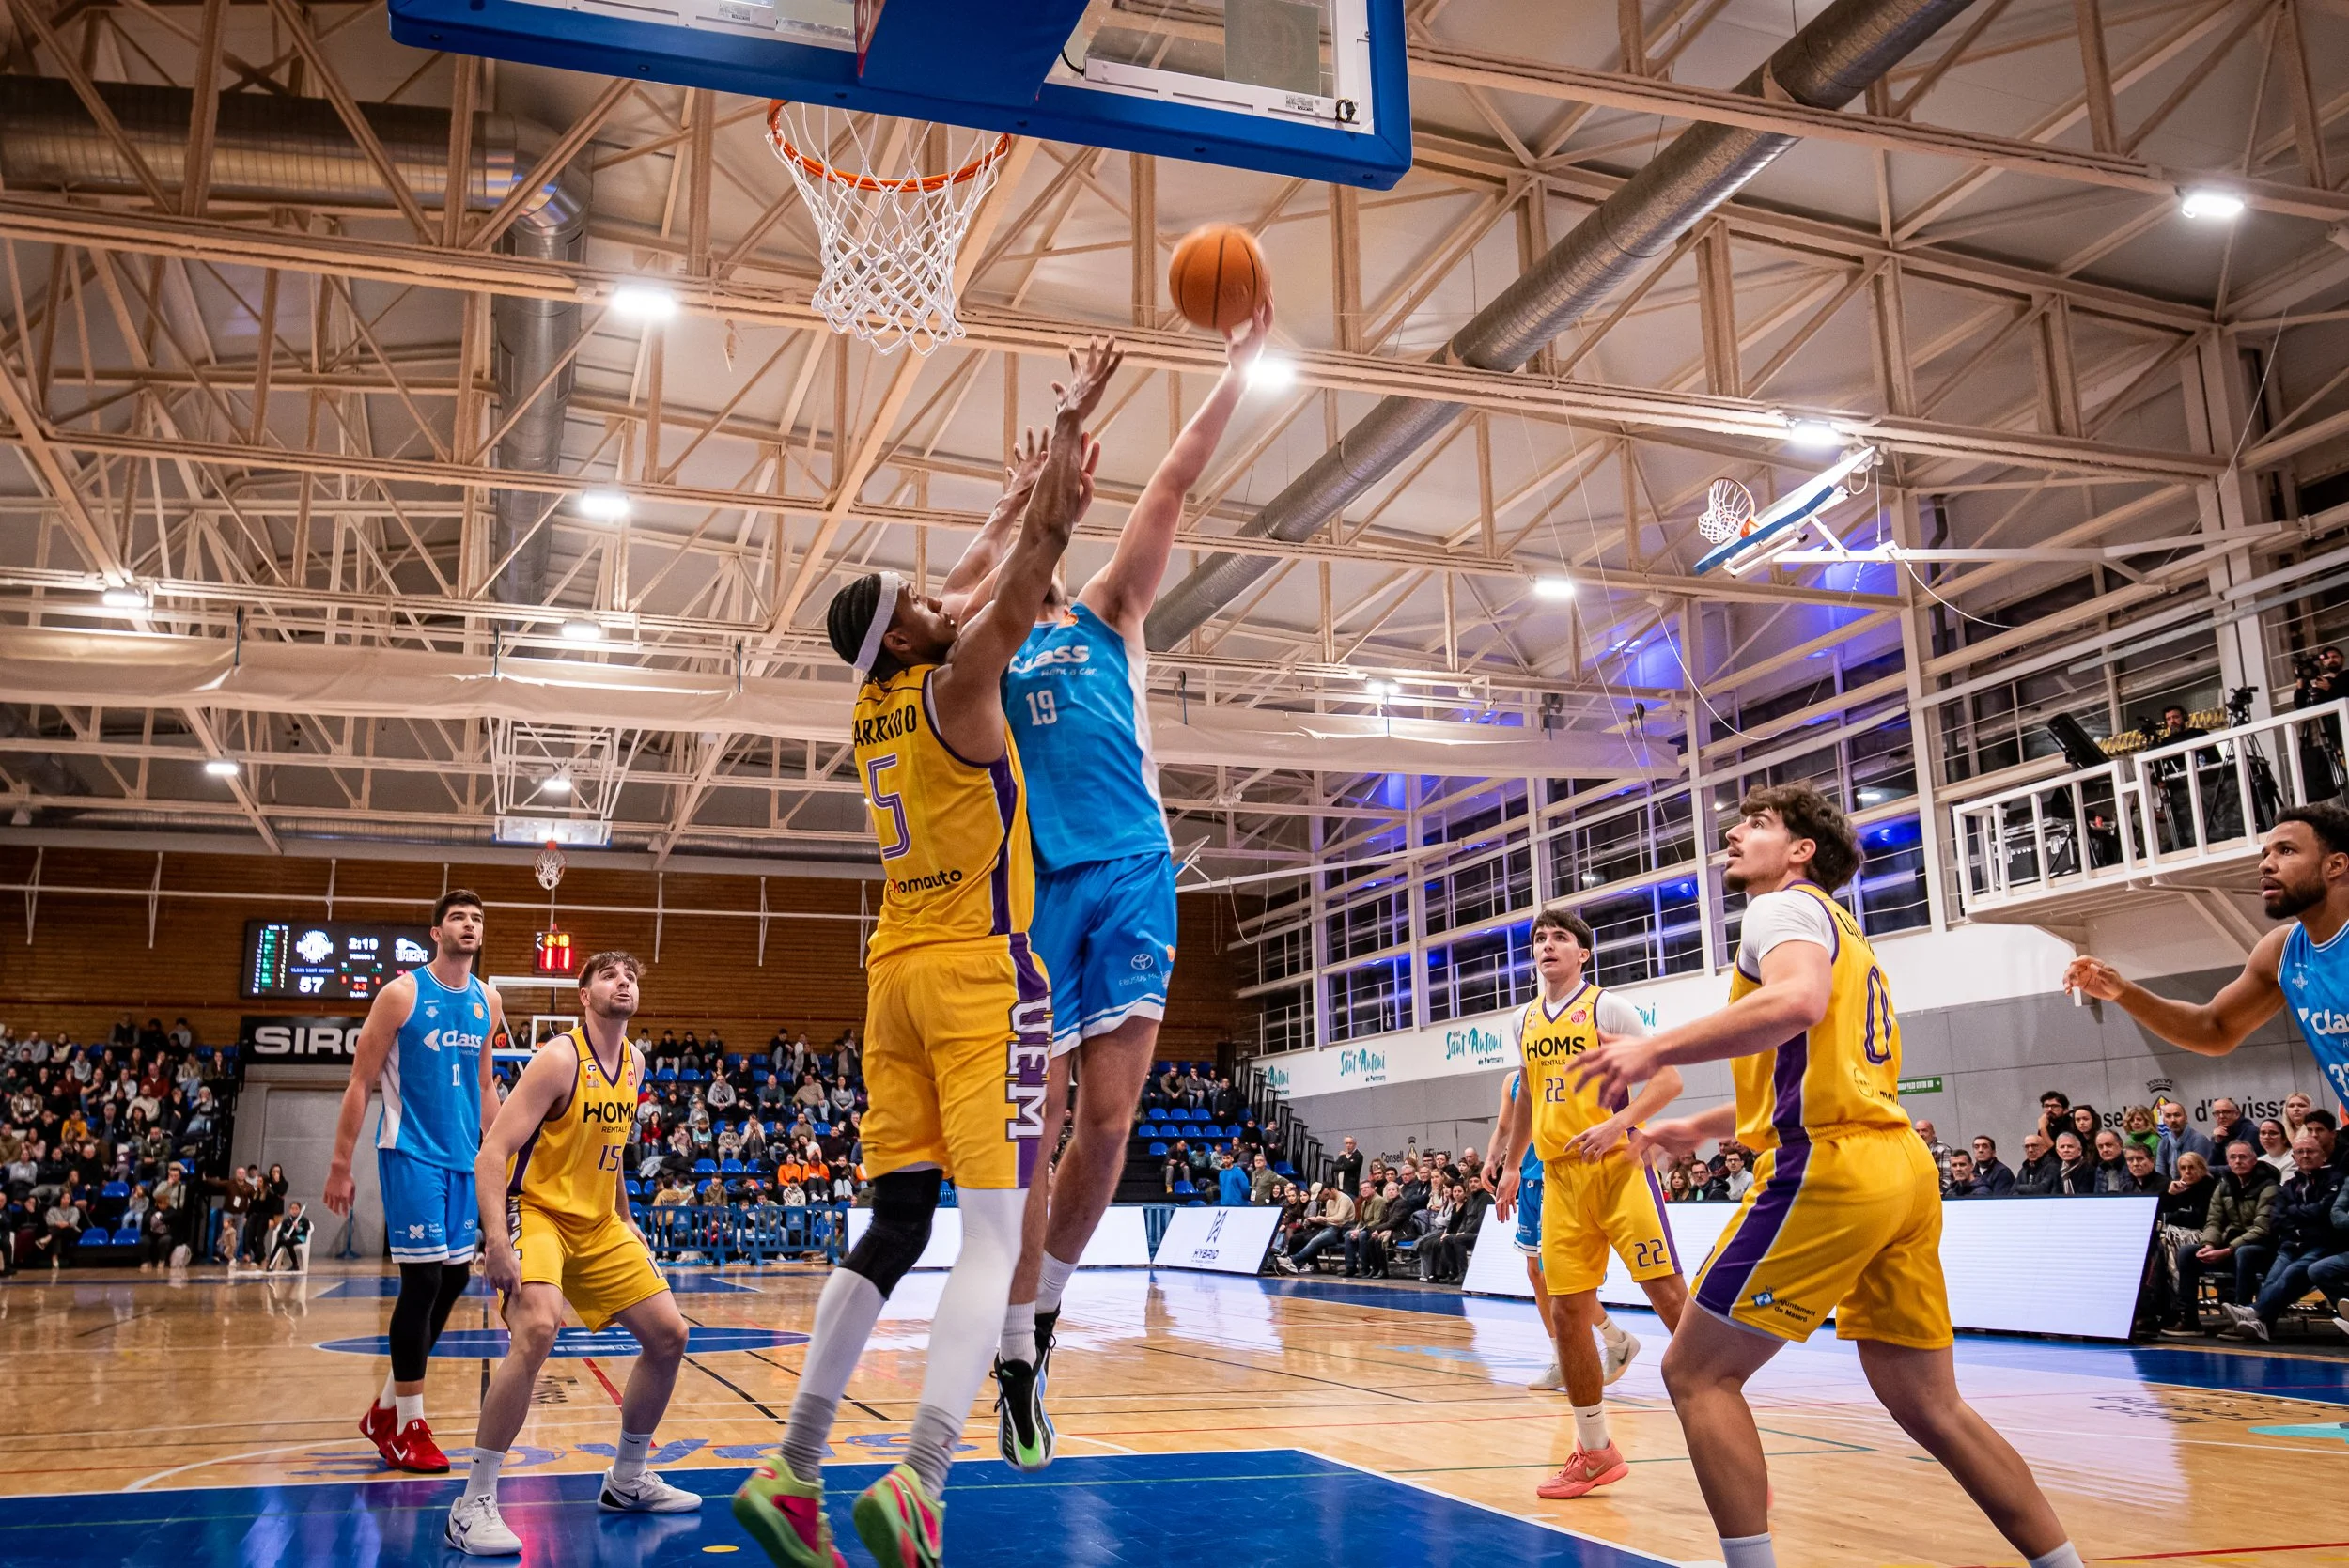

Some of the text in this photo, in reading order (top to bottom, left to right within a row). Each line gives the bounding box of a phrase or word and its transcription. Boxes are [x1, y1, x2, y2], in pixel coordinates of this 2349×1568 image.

[1025, 690, 1058, 726] 19
[852, 705, 917, 749] ARRIDO
[866, 753, 911, 861] 5
[299, 976, 325, 993] 57
[1526, 1036, 1587, 1061] HOMS
[1006, 994, 1054, 1141] UEM
[1540, 1059, 1566, 1067] RENTALS
[1545, 1077, 1566, 1103] 22
[598, 1144, 622, 1172] 15
[1192, 1248, 1220, 1260] HYBRID
[1634, 1238, 1668, 1268] 22
